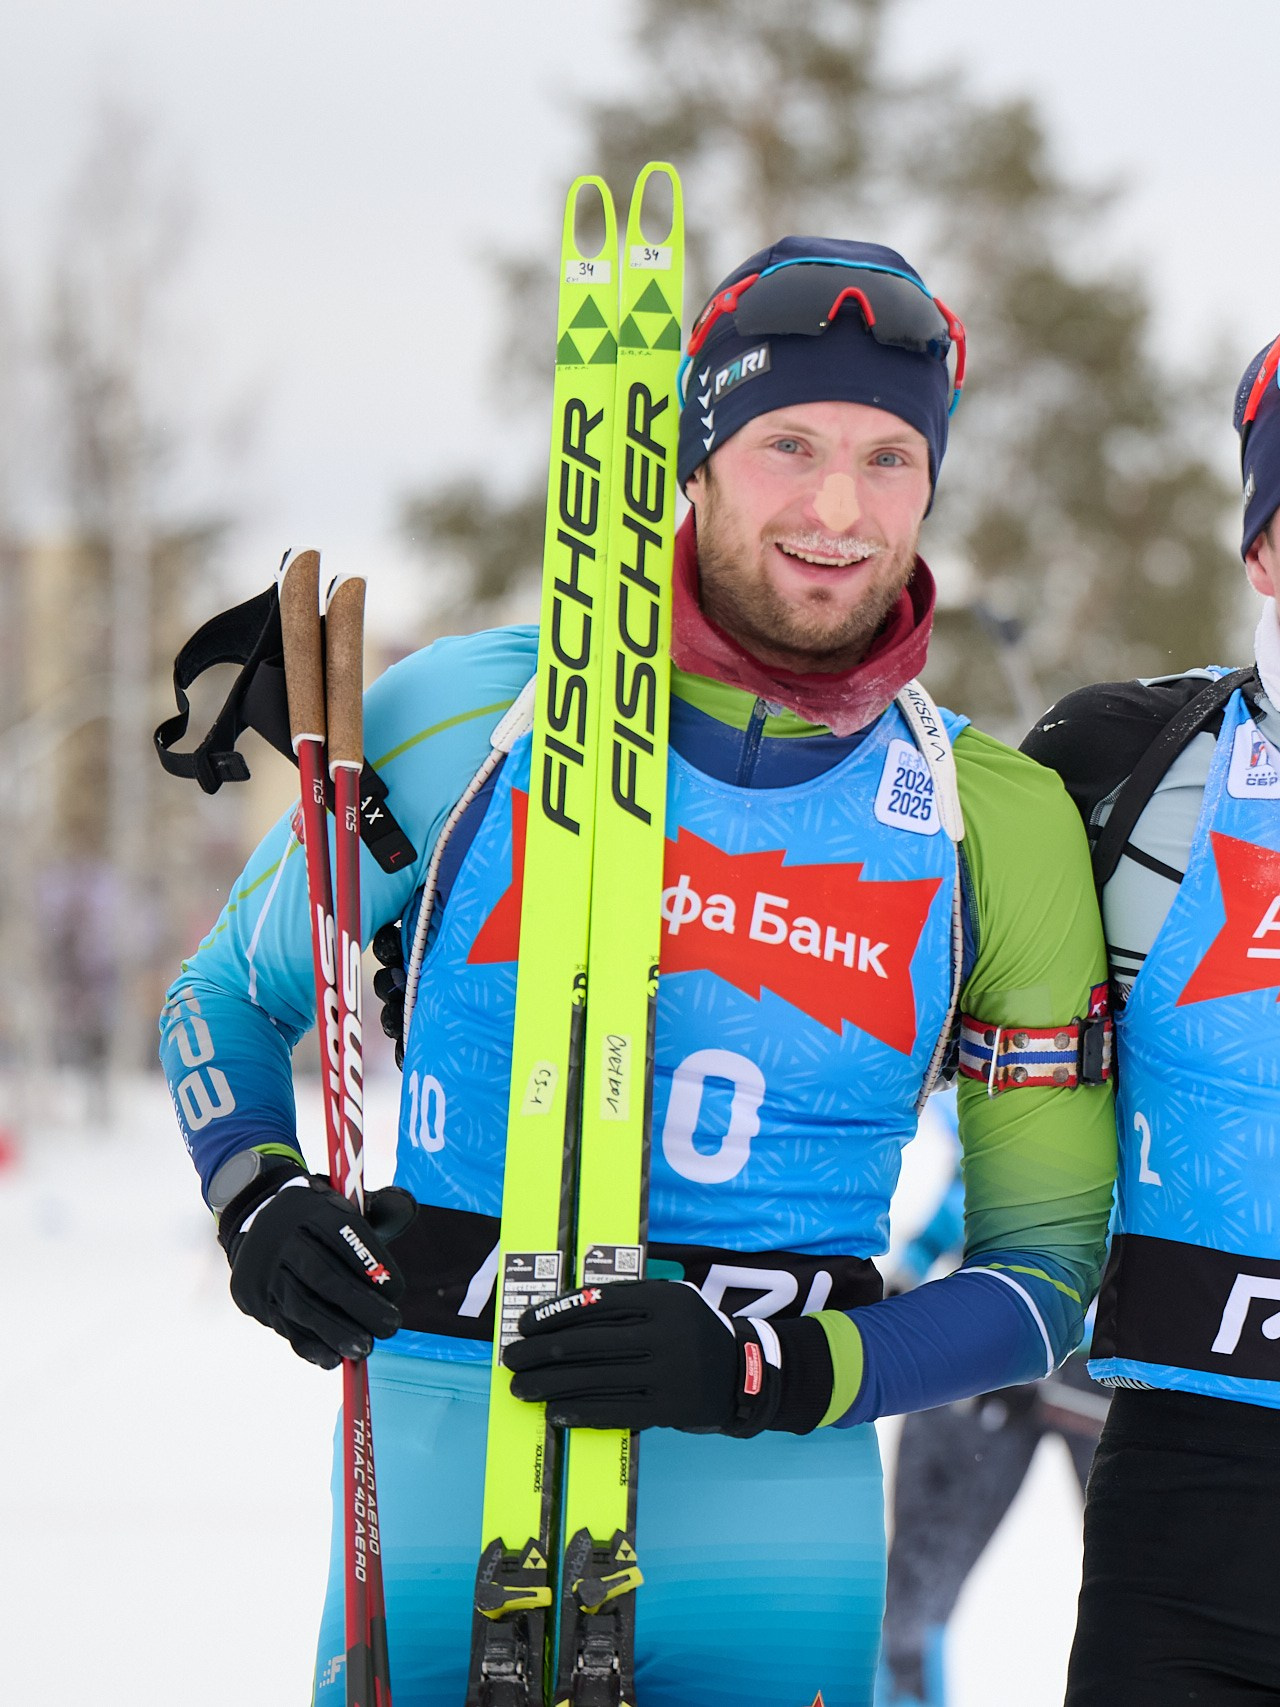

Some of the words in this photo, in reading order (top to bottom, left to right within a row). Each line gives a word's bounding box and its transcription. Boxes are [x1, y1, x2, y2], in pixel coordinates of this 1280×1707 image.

[579, 262, 594, 276] 34
[643, 247, 659, 261] 34
[715, 347, 767, 396] PARI
[543, 397, 605, 836] FISCHER
[612, 381, 669, 827] FISCHER
[899, 680, 940, 738] ARSEN
[887, 789, 933, 821] 2025
[893, 766, 934, 796] 2024
[1245, 777, 1278, 787] СБР
[748, 891, 889, 979] Банк
[341, 929, 364, 1214] SWIX
[407, 1069, 447, 1154] 10
[661, 1048, 768, 1185] 0
[1132, 1110, 1163, 1186] 2
[353, 1419, 365, 1483] TRIAC
[355, 1519, 367, 1583] AERO
